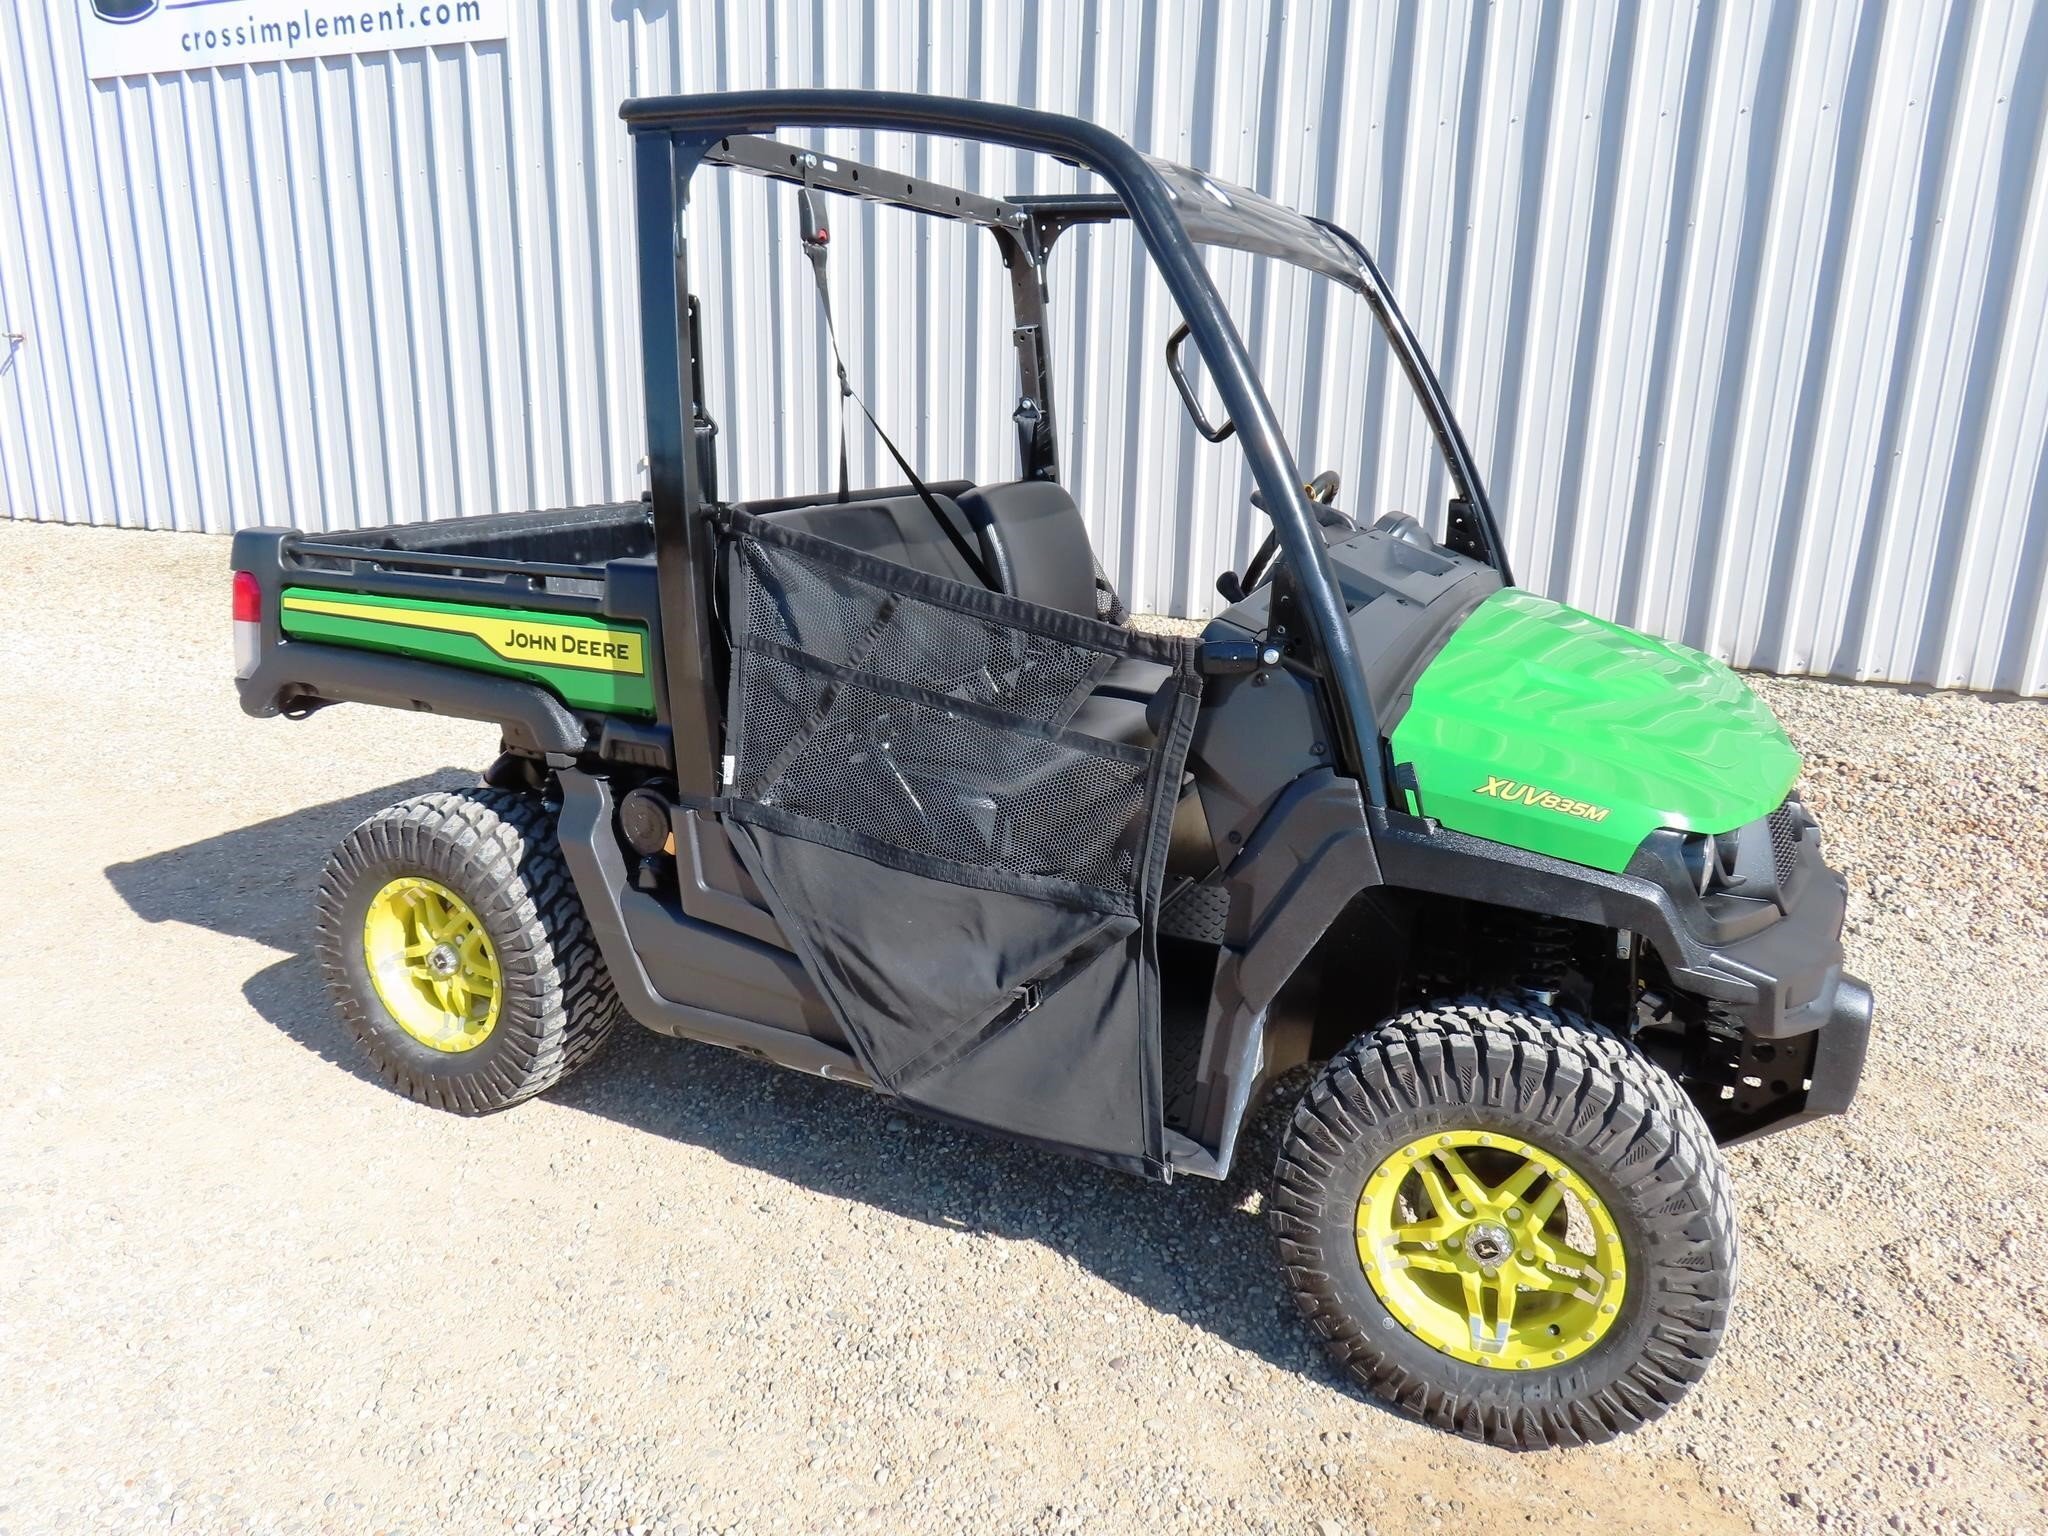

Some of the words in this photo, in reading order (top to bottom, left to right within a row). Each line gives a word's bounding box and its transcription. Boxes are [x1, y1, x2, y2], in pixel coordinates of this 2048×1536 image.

[181, 1, 481, 52] crossimplement.com
[505, 629, 556, 652] JOHN
[562, 634, 629, 660] DEERE
[1473, 775, 1611, 823] XUV835M
